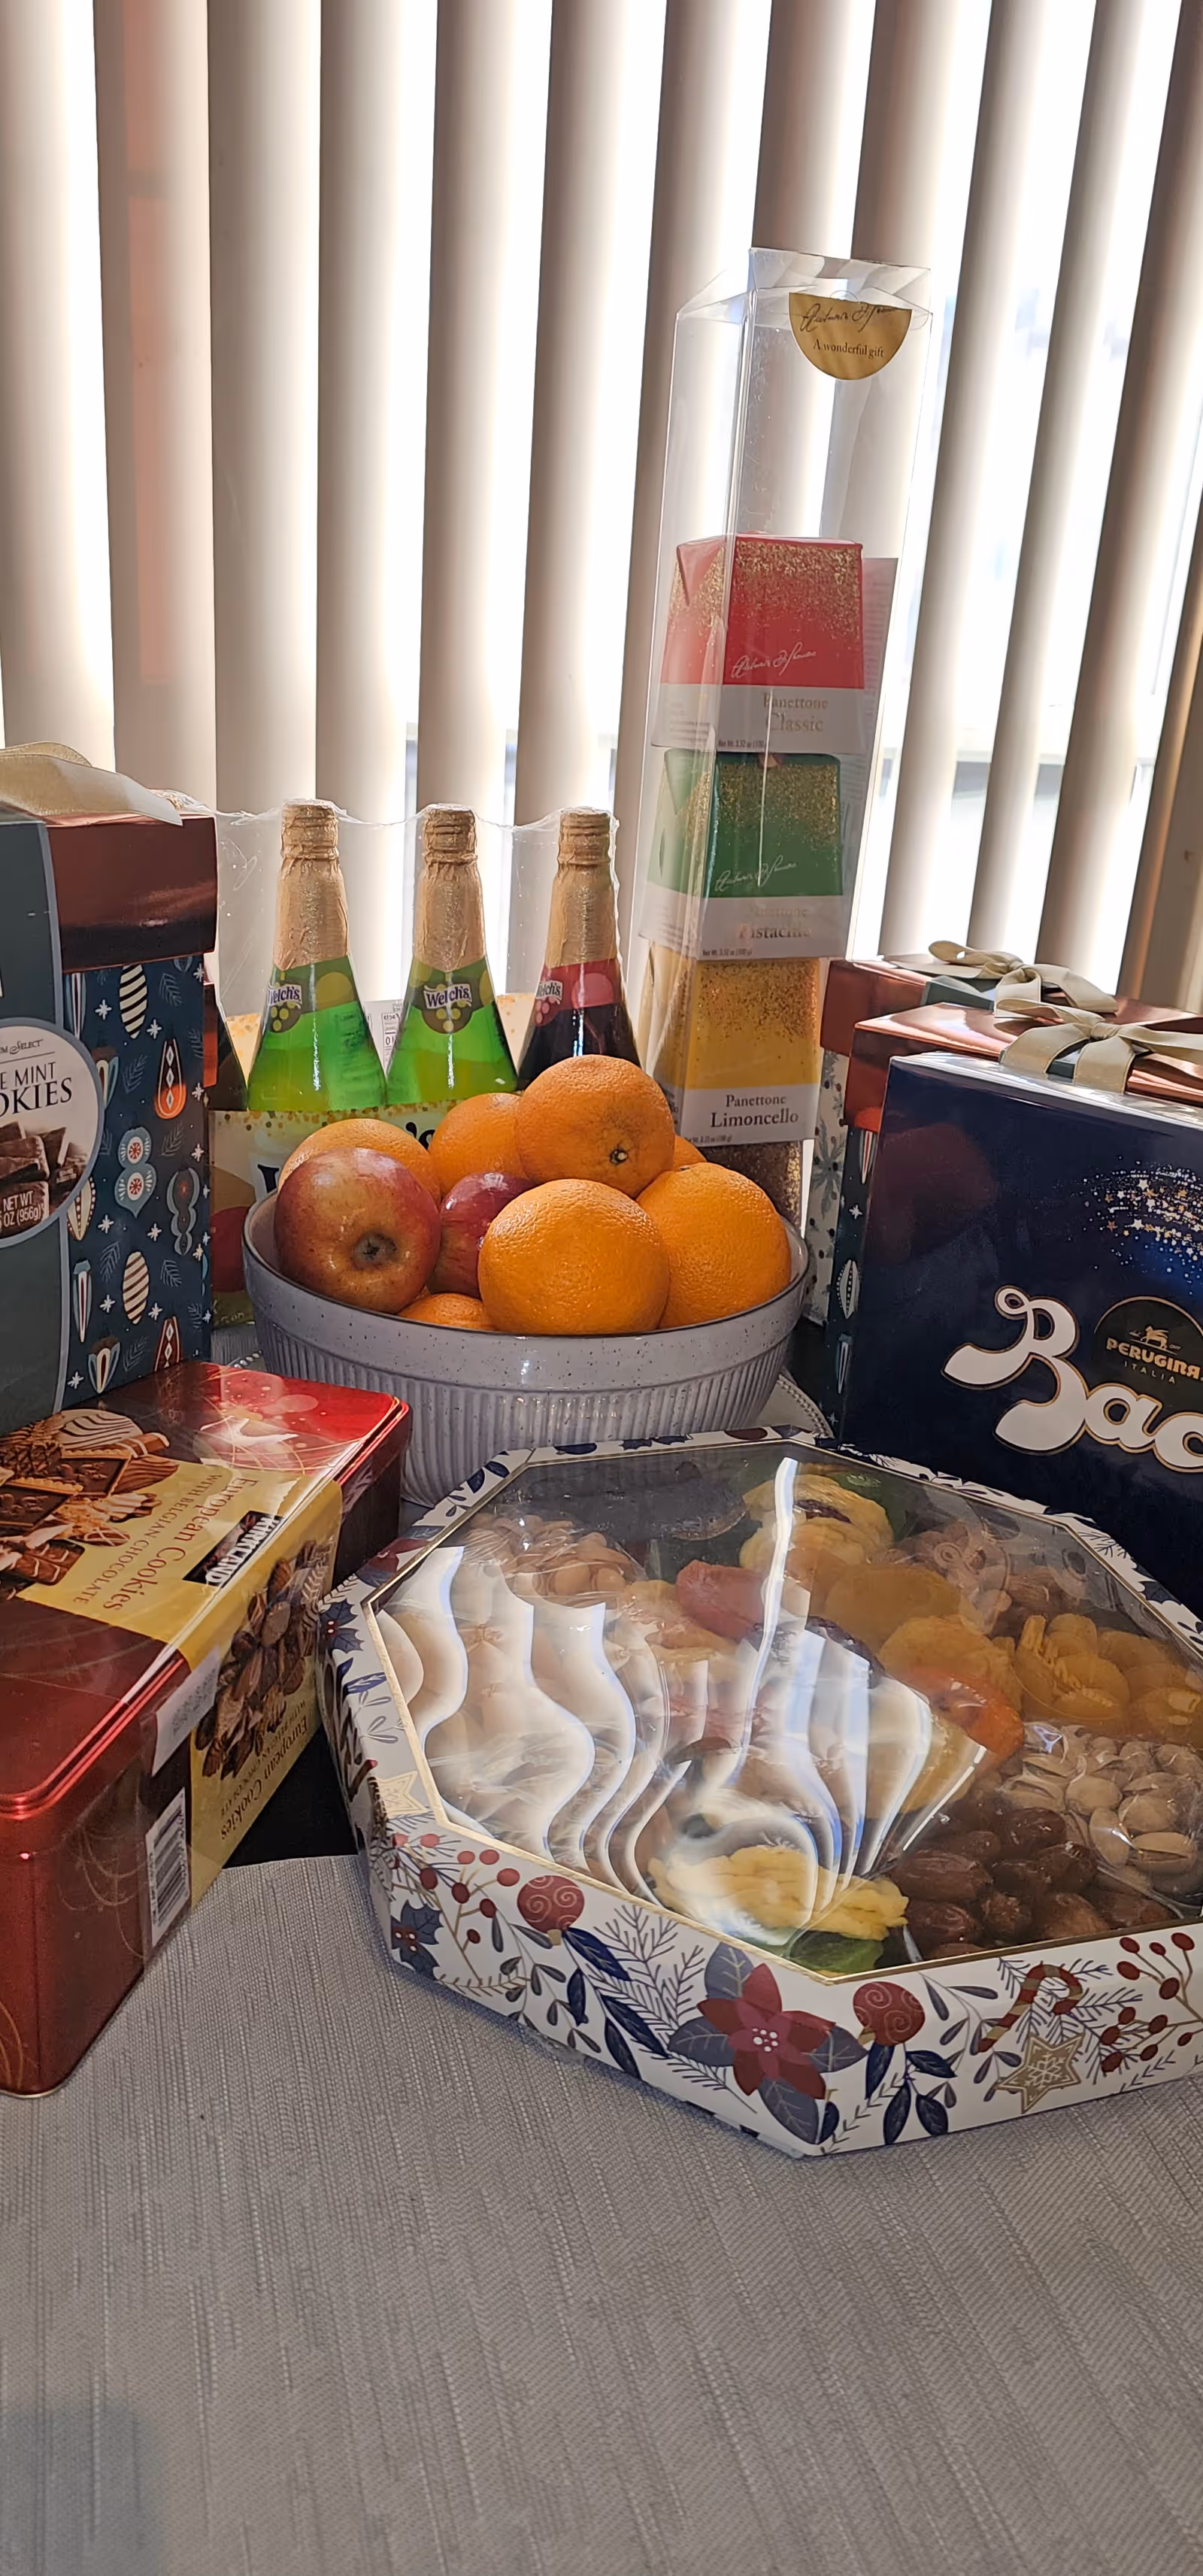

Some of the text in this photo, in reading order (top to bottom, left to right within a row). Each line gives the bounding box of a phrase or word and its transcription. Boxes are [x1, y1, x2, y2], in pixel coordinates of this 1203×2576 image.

[814, 339, 884, 359] A wonderful gift
[763, 692, 829, 710] Panettone
[765, 712, 823, 732] Classic
[426, 986, 470, 1007] Welch's
[15, 1062, 56, 1087] MINT
[726, 1095, 786, 1108] Panettone
[710, 1108, 798, 1128] Limoncello
[2, 1190, 34, 1212] NET WT
[3, 1204, 41, 1227] OZ (956g)
[1106, 1338, 1201, 1380] PERUGINA
[1124, 1360, 1175, 1384] ITALIA
[73, 1474, 222, 1605] WITH BELGIAN CHOCOLATE
[103, 1477, 259, 1611] European Cookies
[220, 1716, 308, 1841] European Cookies
